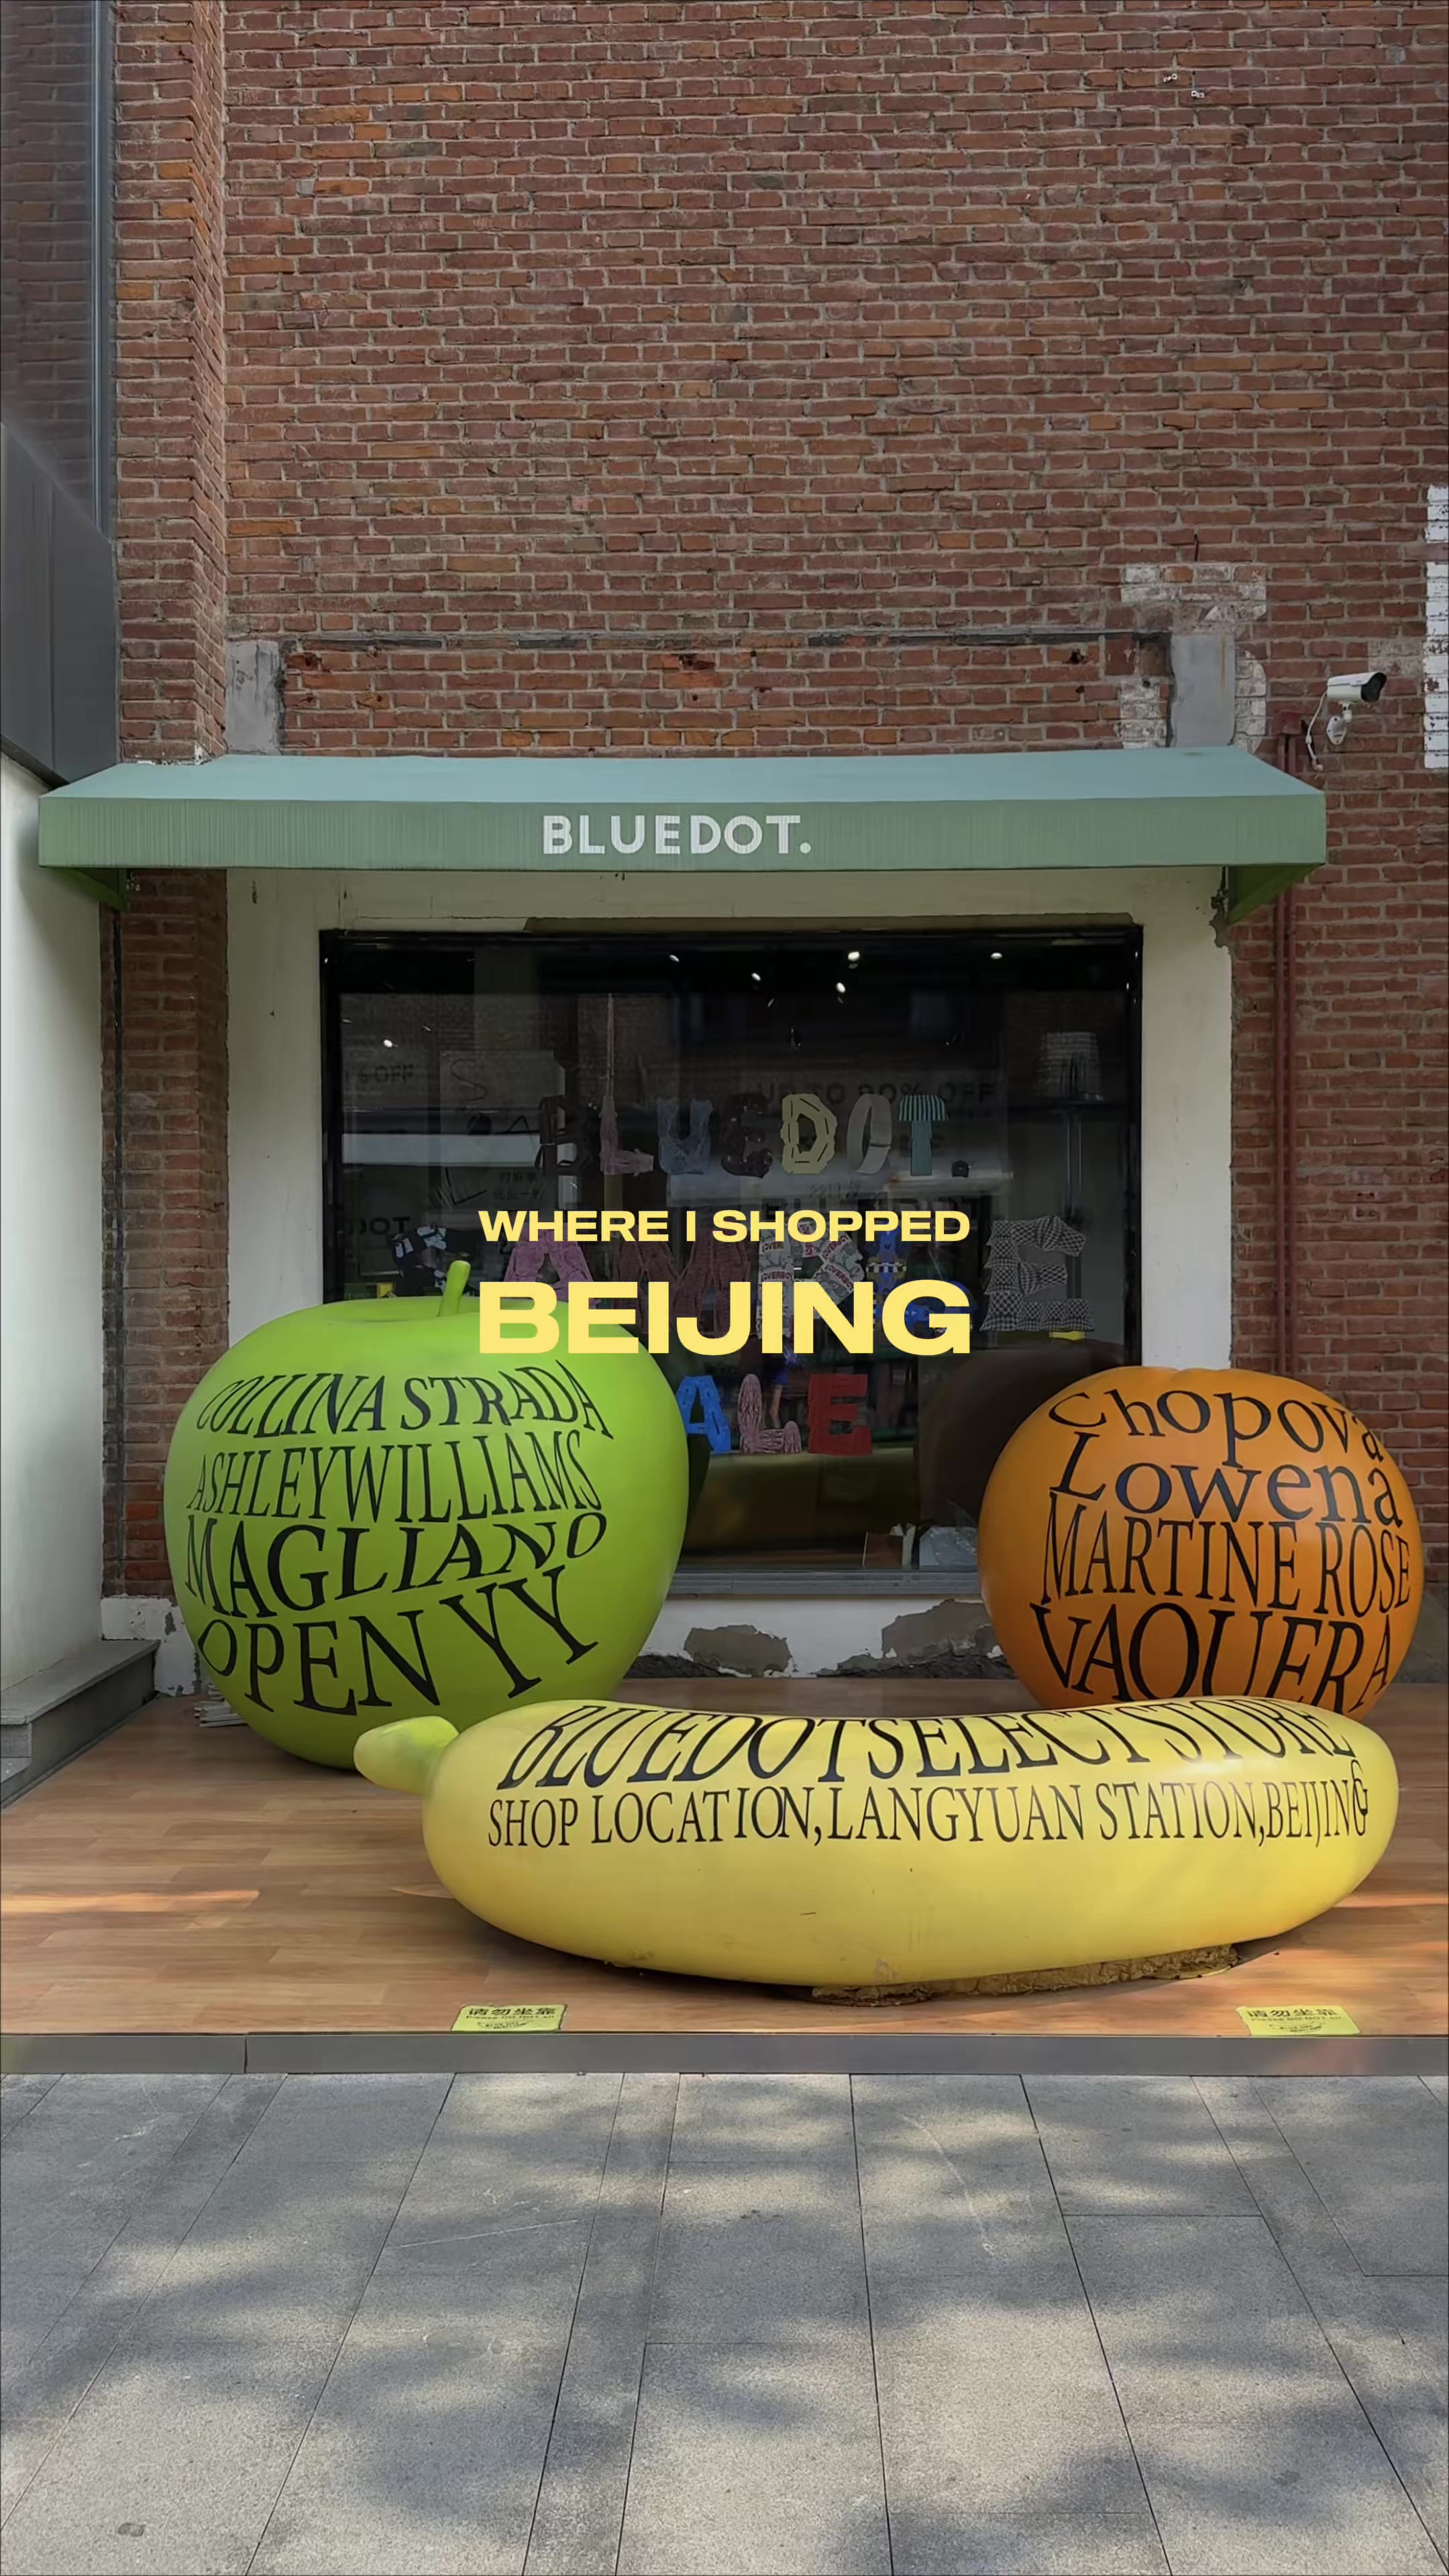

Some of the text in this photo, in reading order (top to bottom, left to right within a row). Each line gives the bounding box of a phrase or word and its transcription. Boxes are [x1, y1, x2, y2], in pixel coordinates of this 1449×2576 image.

[543, 815, 811, 854] BLUEDOT.
[197, 1359, 614, 1440] COLLINA STRADA
[676, 1373, 873, 1456] ALE
[1048, 1388, 1385, 1469] Chopova
[1049, 1431, 1403, 1529] Lowena
[184, 1511, 607, 1619] MAGLIANO
[1040, 1491, 1411, 1618] MARTINE ROSE
[197, 1564, 599, 1717] OPEN YY
[488, 1797, 579, 1849] SHOP
